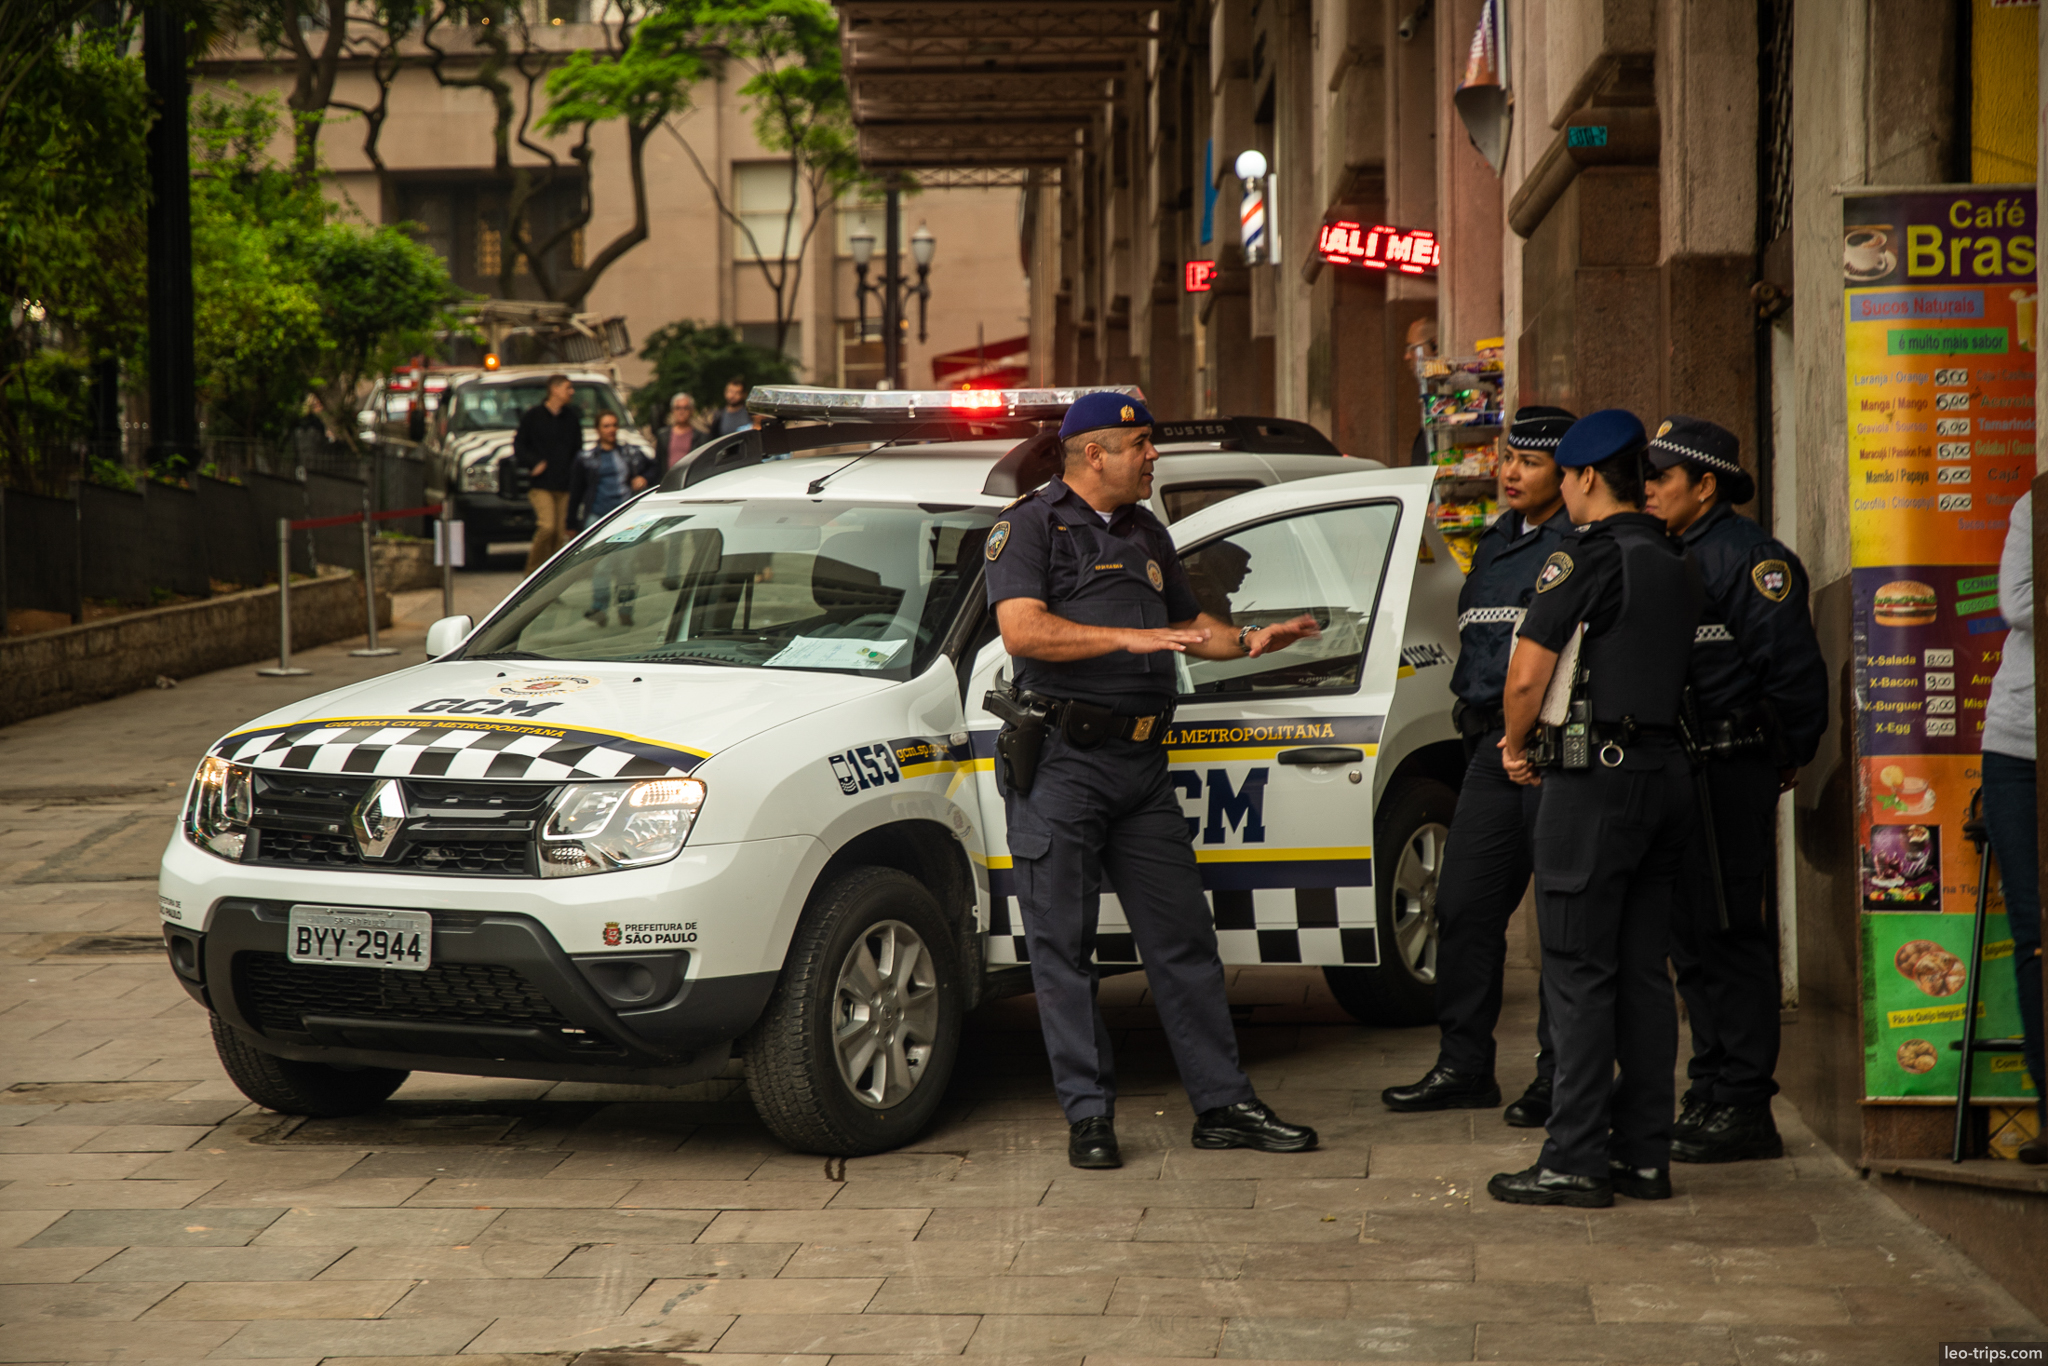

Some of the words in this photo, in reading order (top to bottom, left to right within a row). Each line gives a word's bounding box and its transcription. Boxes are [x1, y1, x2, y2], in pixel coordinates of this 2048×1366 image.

[1950, 199, 2026, 229] Café
[1861, 299, 1909, 316] Sucos
[1914, 296, 1975, 314] Naturais
[1908, 333, 1940, 350] muito
[1943, 334, 1969, 349] mais
[1971, 334, 2004, 348] sabor
[1854, 372, 1888, 387] Laranja
[1896, 371, 1930, 386] Orange
[1861, 399, 1890, 414] Manga
[1898, 397, 1929, 412] Mango
[1163, 425, 1226, 437] DUSTER
[1857, 422, 1889, 435] Graviola
[1866, 469, 1894, 485] Mamão
[1901, 468, 1930, 485] Papaya
[1867, 654, 1916, 667] X-Salada
[1869, 677, 1918, 689] X-Bacon
[408, 698, 565, 717] GCM
[1864, 701, 1923, 713] X-Burguer
[433, 721, 566, 738] METROPOLITANA
[1181, 723, 1336, 745] METROPOLITANA
[1875, 722, 1911, 735] X-Egg
[847, 743, 900, 791] 153
[625, 923, 683, 931] PREFEITURA
[685, 922, 697, 930] DE
[625, 932, 653, 944] SÃO
[655, 932, 698, 943] PAULO
